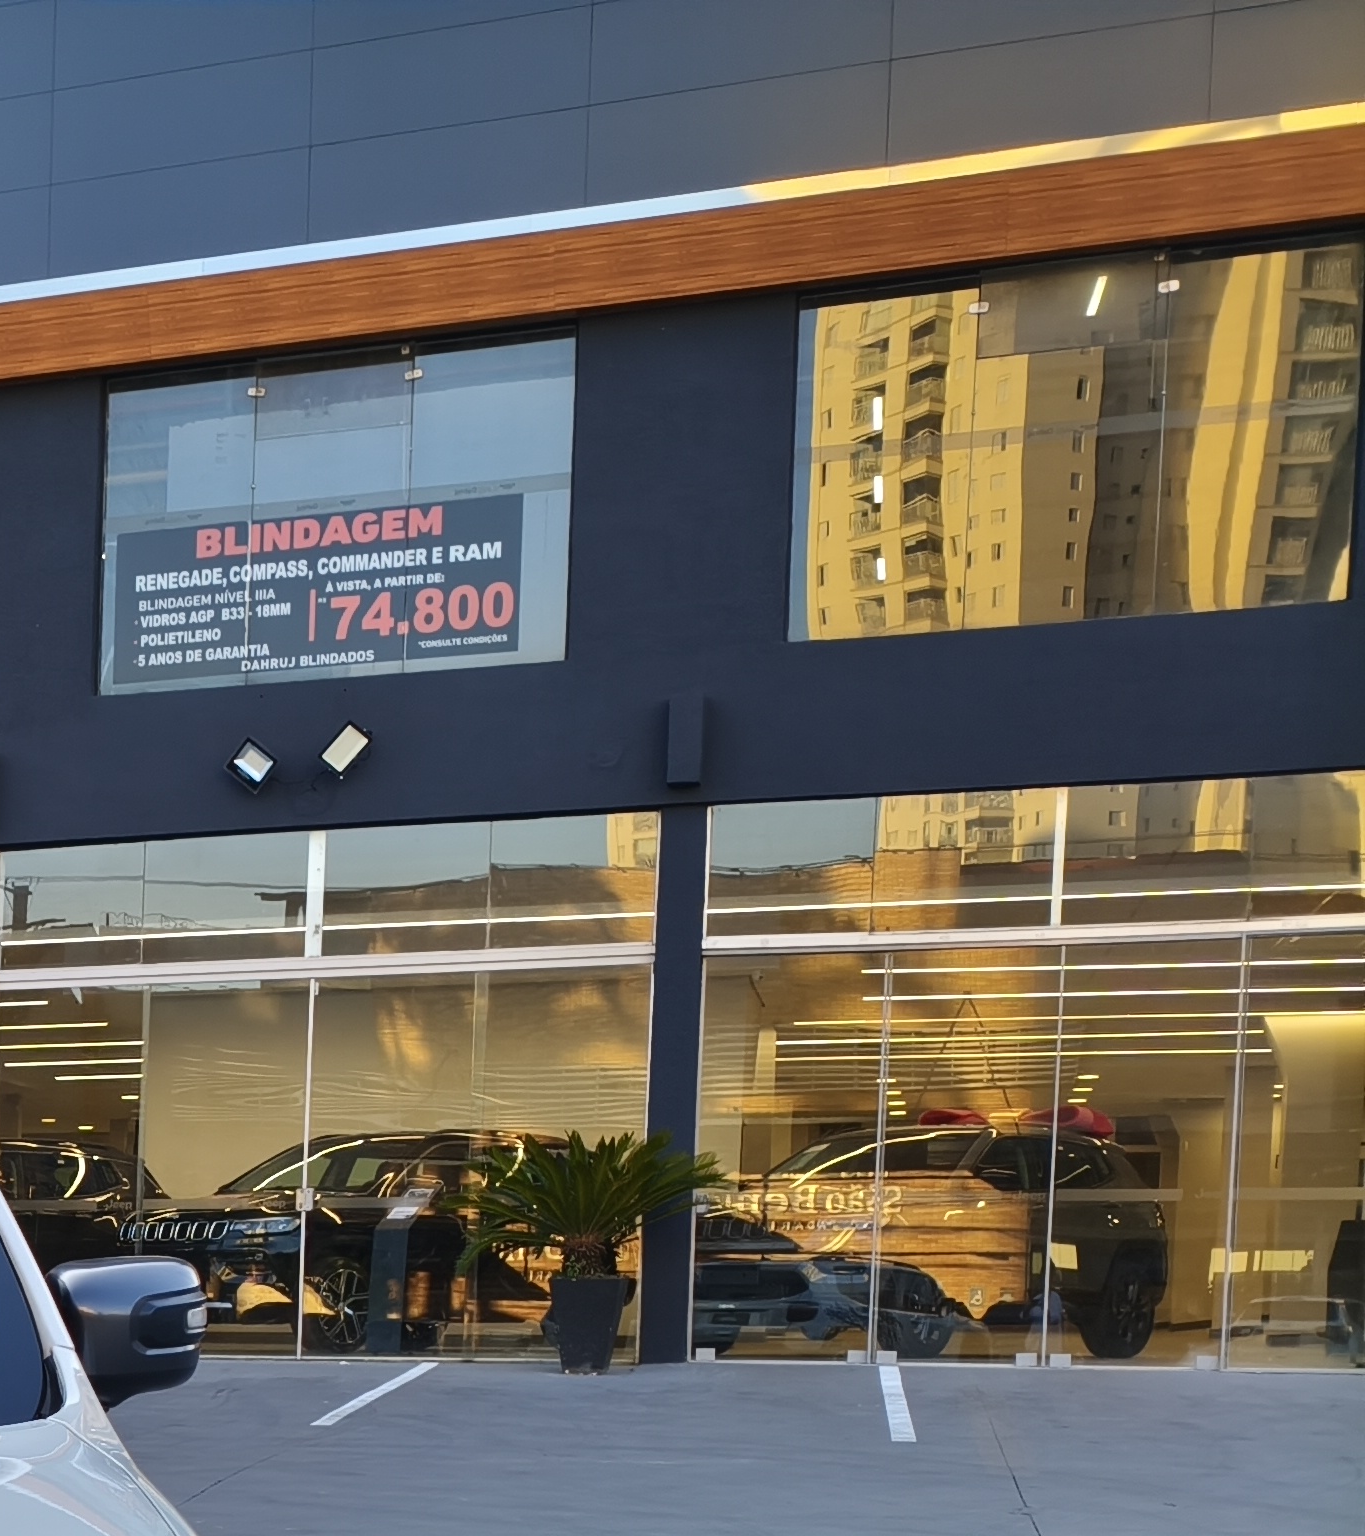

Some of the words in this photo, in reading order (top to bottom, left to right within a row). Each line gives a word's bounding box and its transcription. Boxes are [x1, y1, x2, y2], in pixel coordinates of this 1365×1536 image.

[196, 505, 443, 559] BLINDAGEM
[135, 567, 227, 593] RENEGADE,
[229, 559, 313, 583] COMPASS,
[317, 548, 427, 574] COMMANDER
[432, 546, 443, 564] E
[449, 541, 502, 562] RAM
[373, 577, 381, 589] A
[384, 574, 424, 588] PARTIR
[139, 594, 212, 611] BLINDAGEM
[214, 589, 252, 604] NÍVEL
[255, 588, 276, 601] IIIA
[330, 581, 515, 640] 74.800
[140, 612, 186, 628] VIDROS
[189, 609, 215, 624] AGP
[221, 606, 245, 621] B33
[255, 602, 291, 618] 18MM
[140, 628, 222, 648] POLIETILENO
[138, 654, 146, 667] 5
[148, 650, 183, 666] ANOS
[185, 649, 203, 663] DE
[205, 643, 270, 661] GARANTIA
[240, 657, 296, 672] DAHRUJ
[299, 650, 375, 667] BLINDADOS
